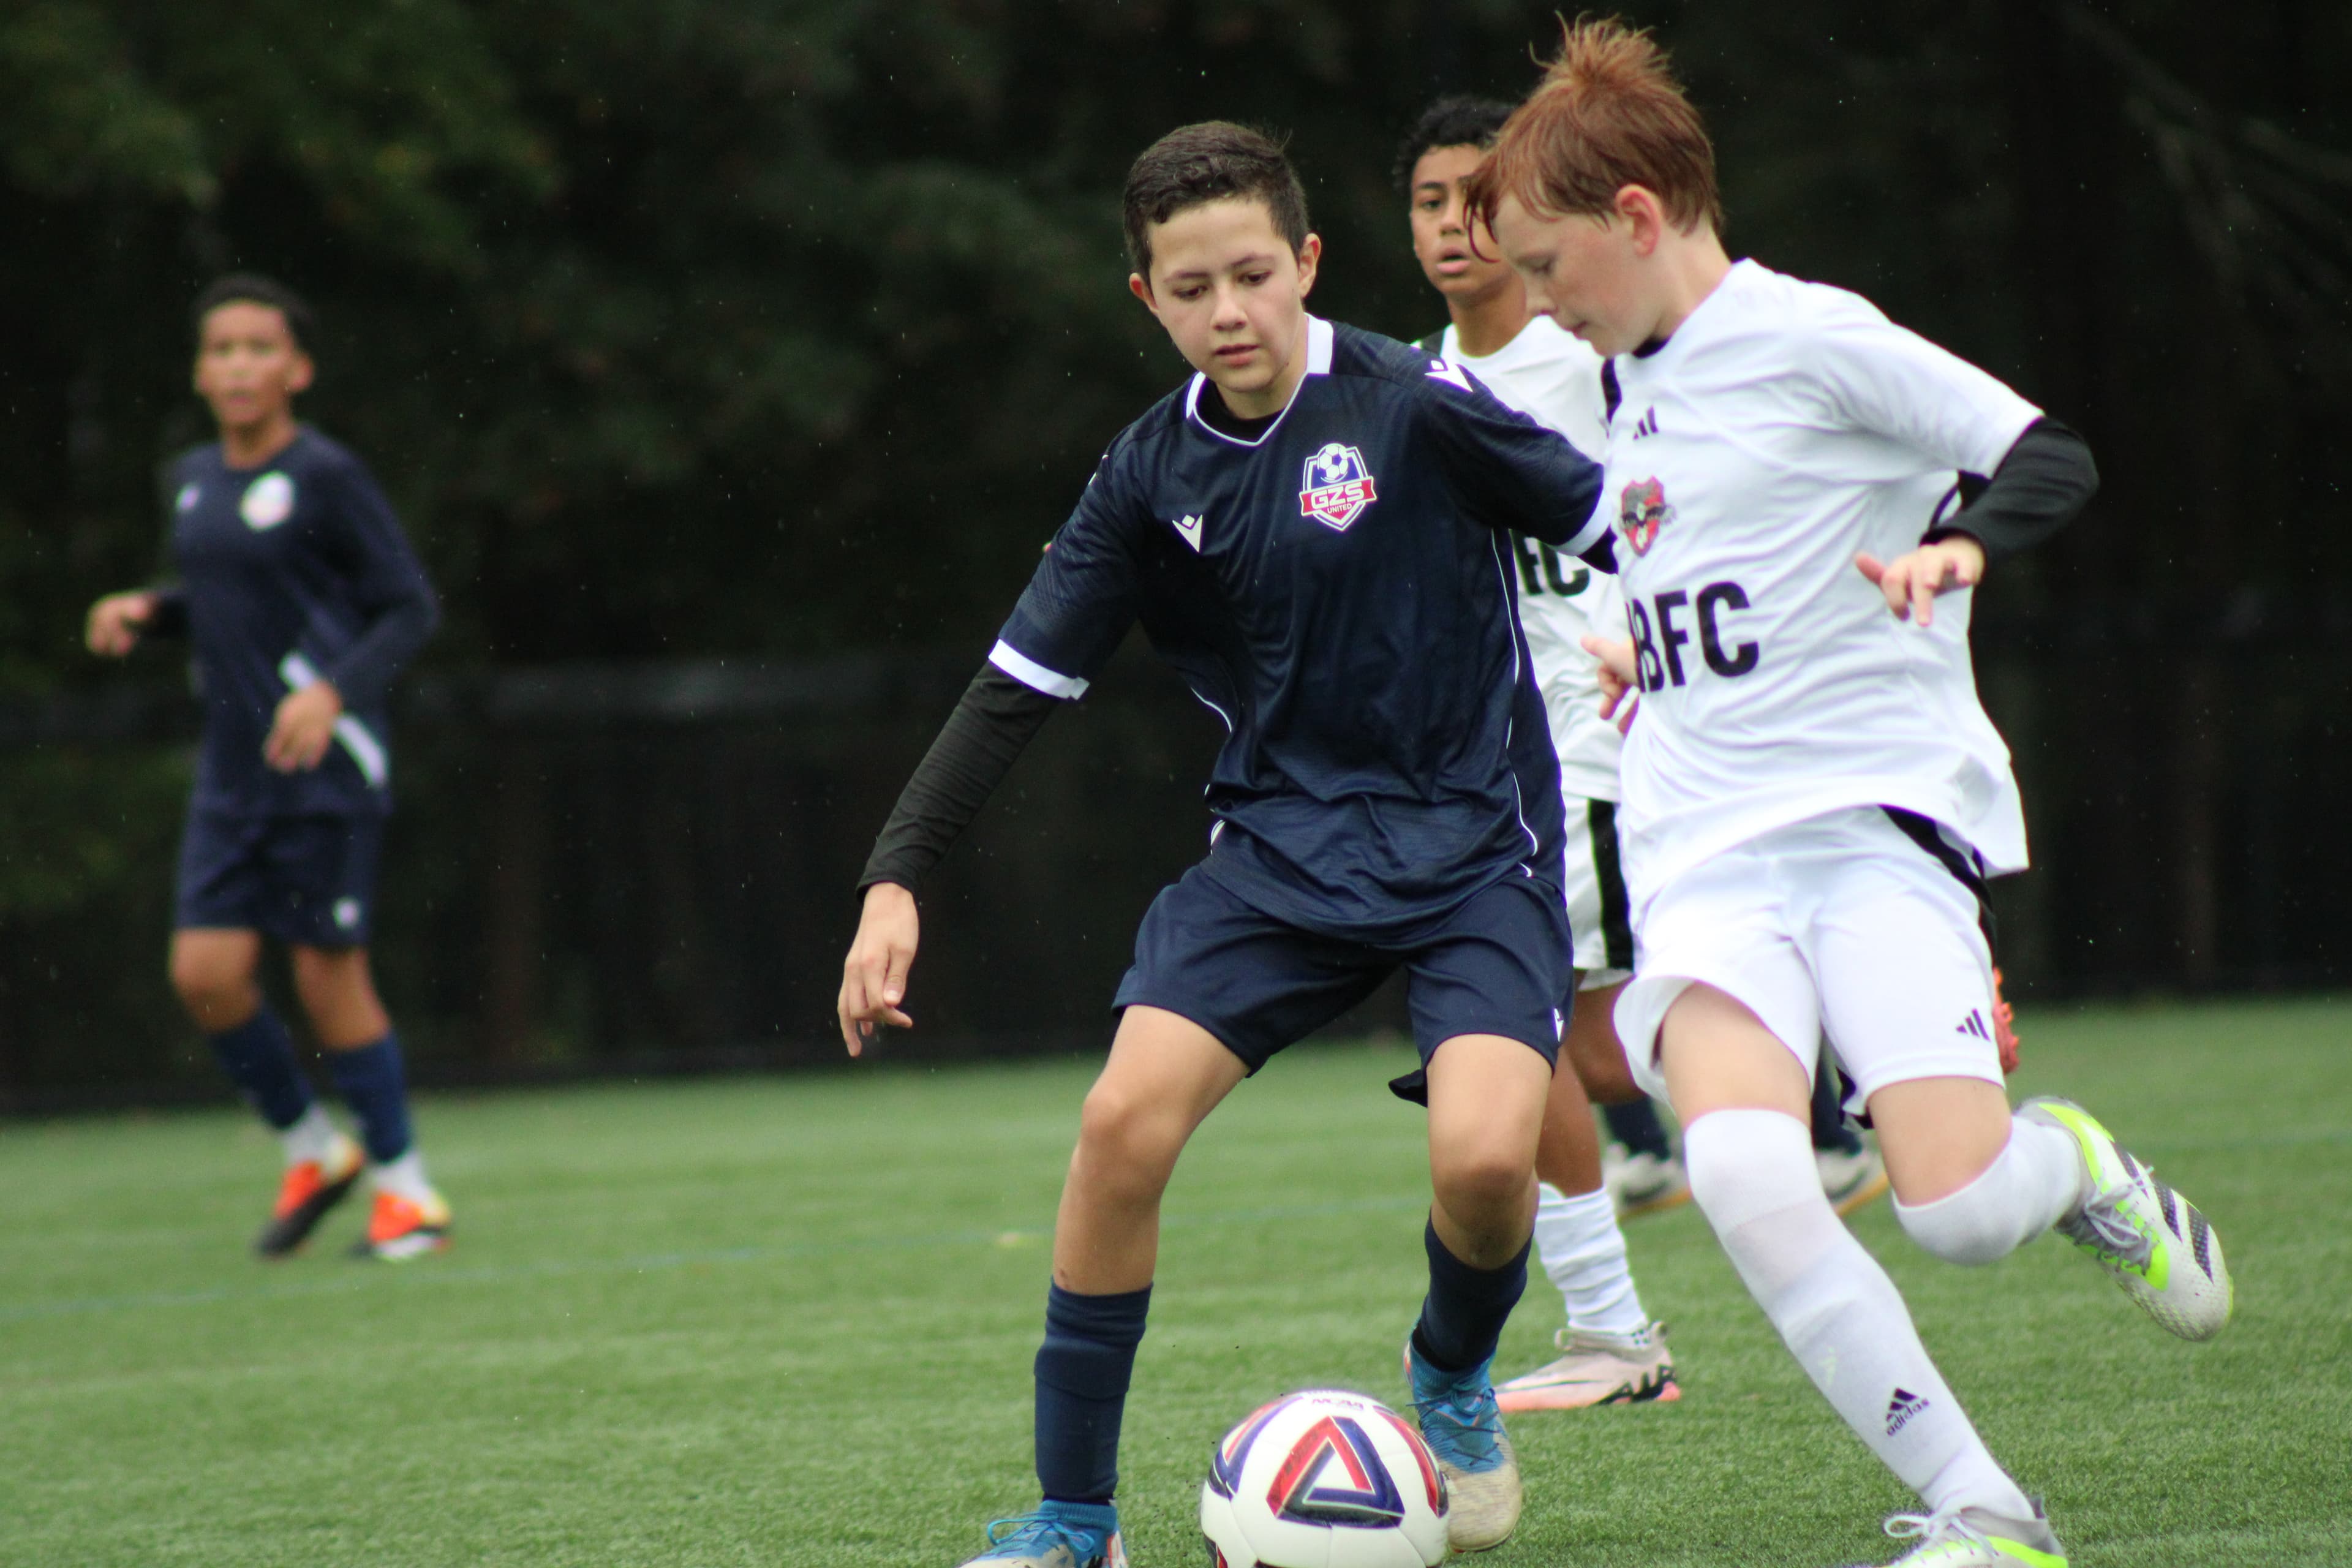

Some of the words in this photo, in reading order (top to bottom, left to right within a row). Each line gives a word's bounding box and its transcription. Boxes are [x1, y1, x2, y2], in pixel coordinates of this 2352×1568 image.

[1311, 482, 1365, 509] GZS
[1327, 503, 1352, 514] UNITED
[1626, 581, 1759, 693] BFC
